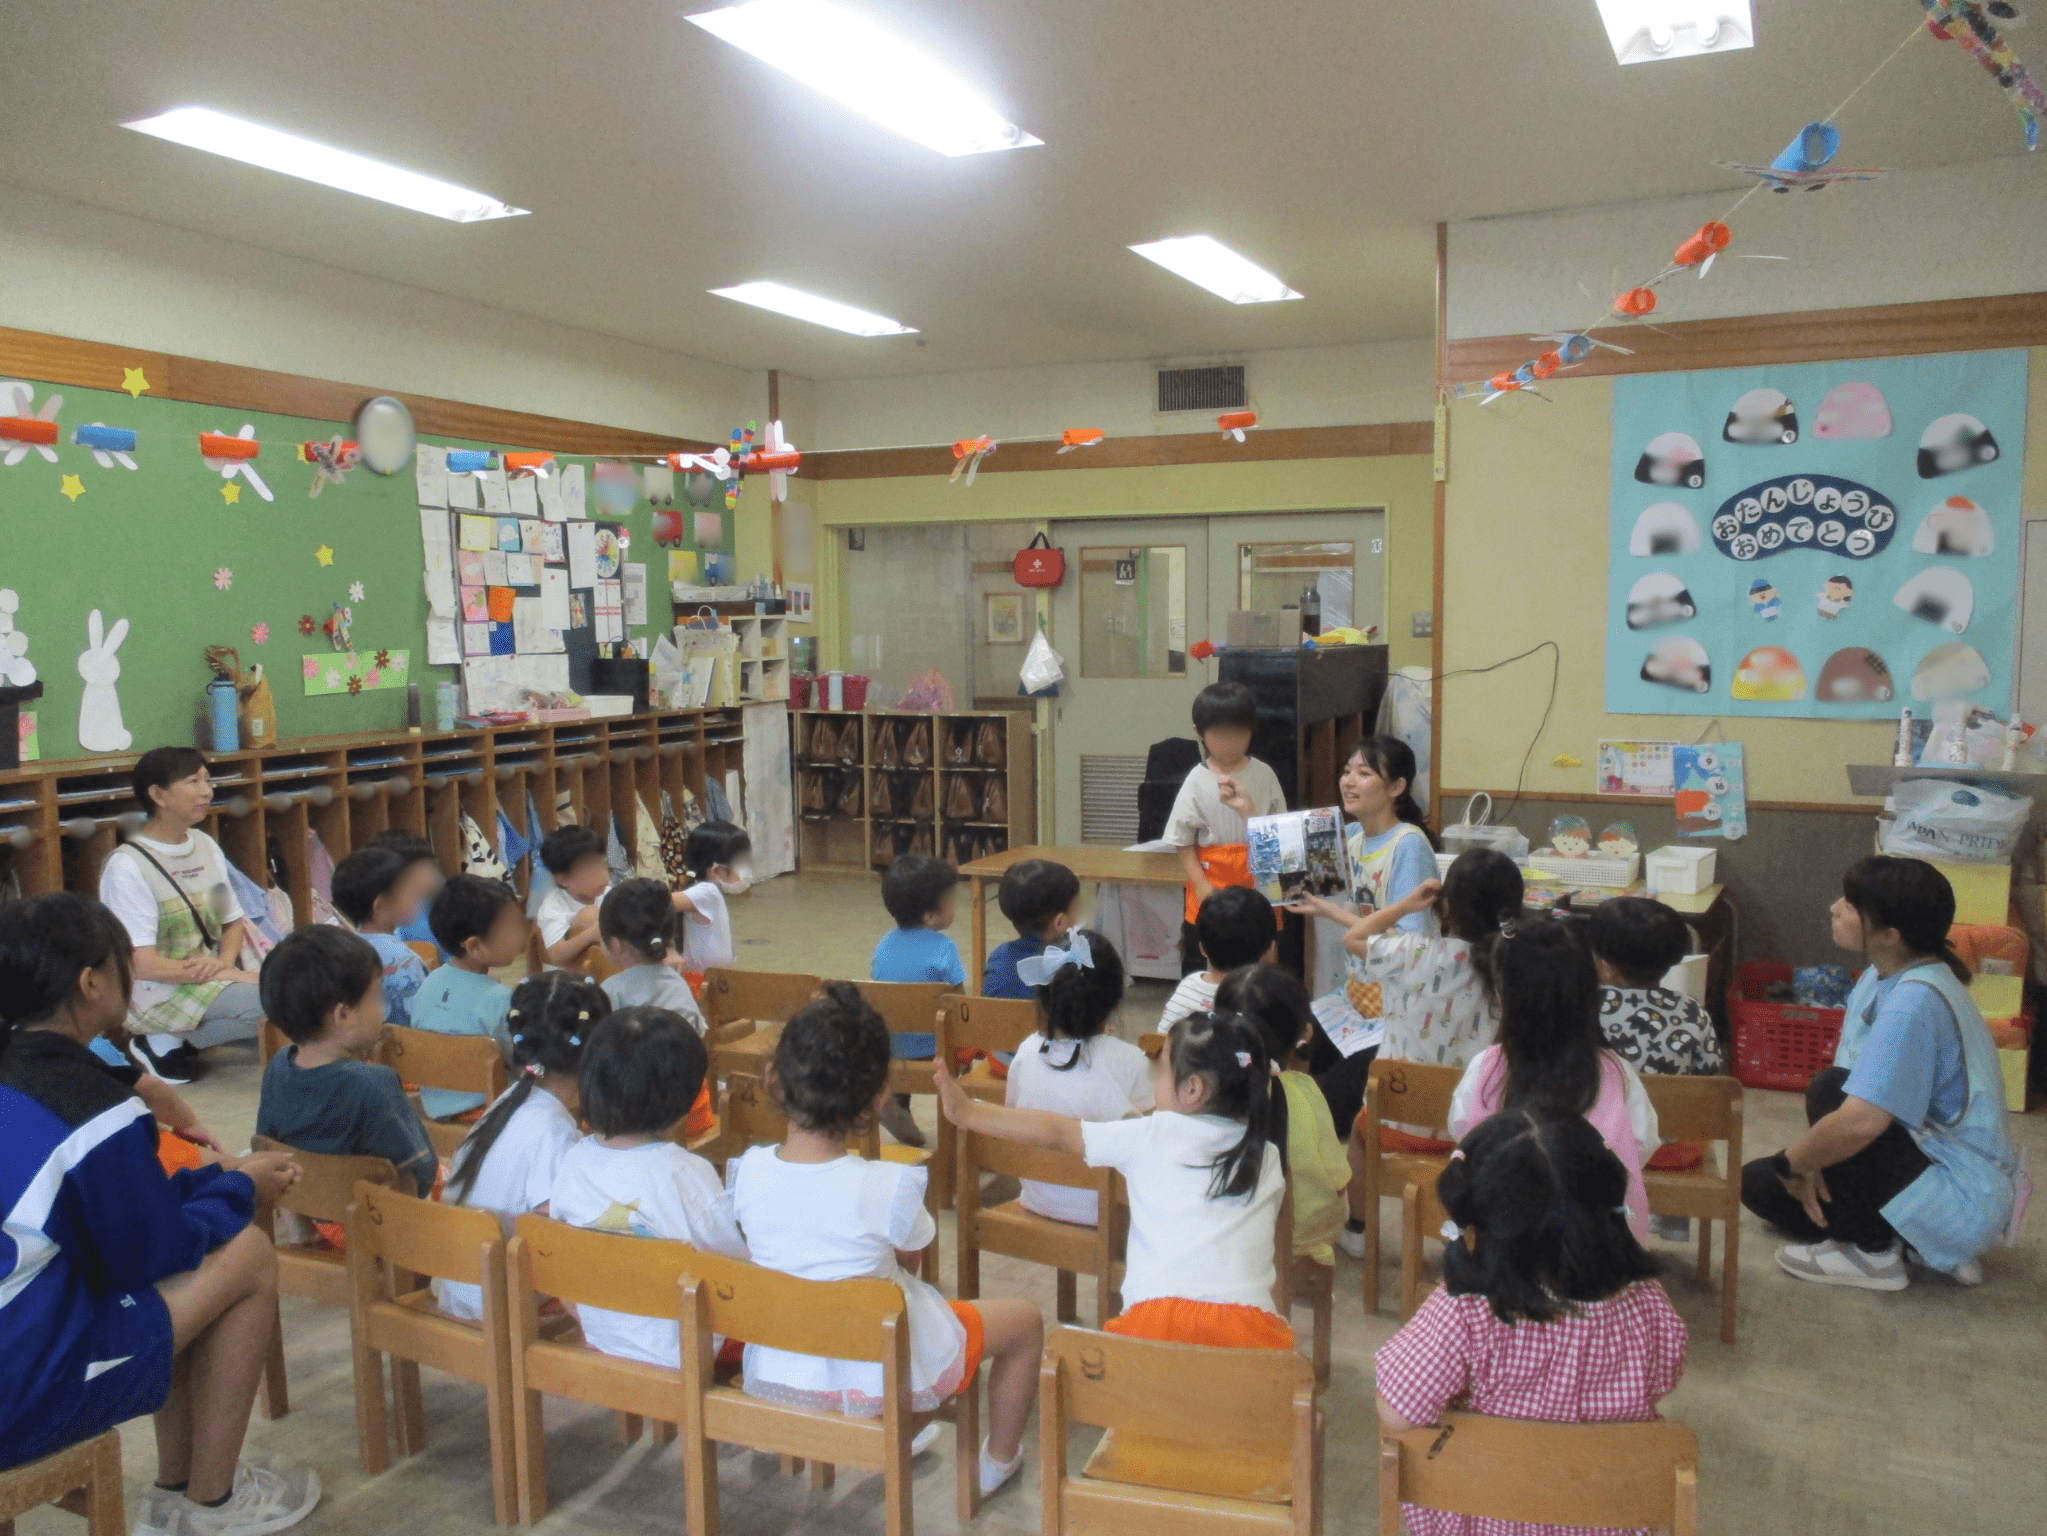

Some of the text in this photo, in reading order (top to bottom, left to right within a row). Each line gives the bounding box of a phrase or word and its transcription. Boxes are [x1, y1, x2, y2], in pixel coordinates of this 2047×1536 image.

[1716, 482, 1892, 540] おたんじょうび
[1735, 521, 1870, 558] おめでとう
[1706, 757, 1713, 766] 9
